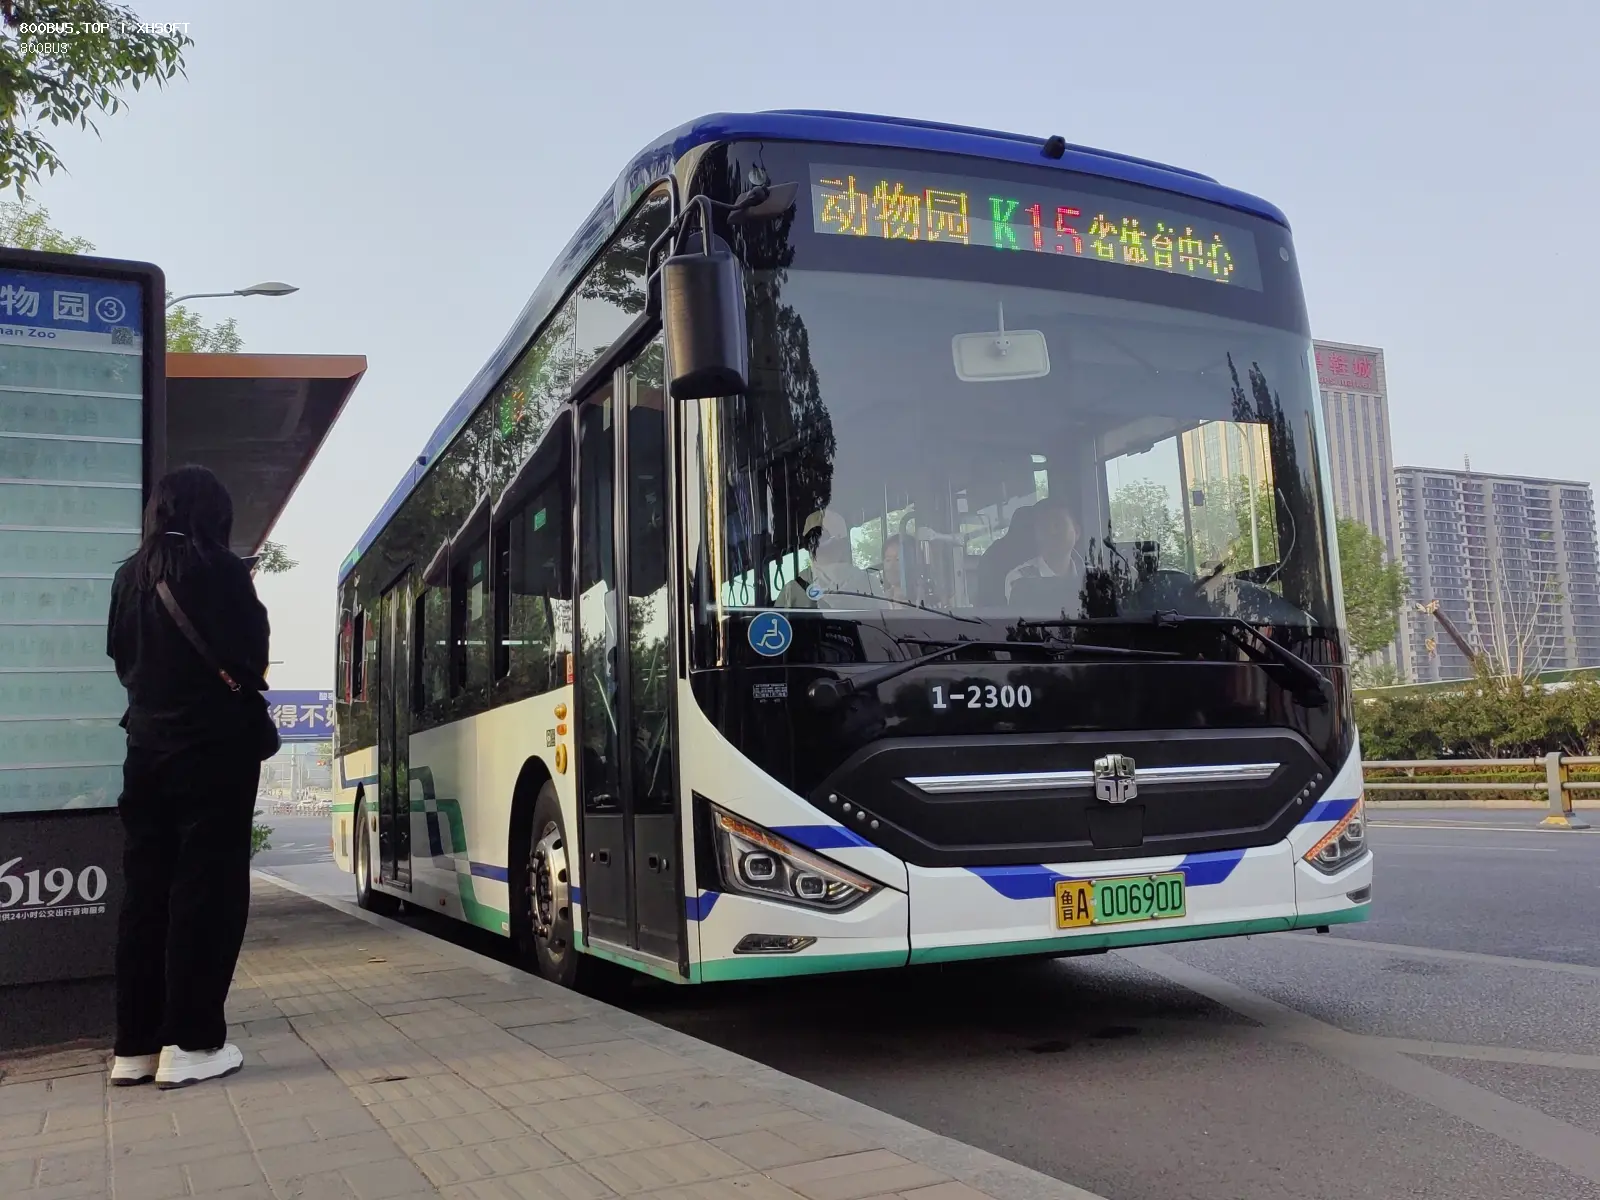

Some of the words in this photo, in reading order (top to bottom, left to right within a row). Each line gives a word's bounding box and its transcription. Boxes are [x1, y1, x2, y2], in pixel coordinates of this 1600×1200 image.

[820, 175, 968, 245] 动物园
[989, 197, 1082, 254] K15
[28, 328, 56, 339] Zoo
[932, 685, 1032, 709] 1-2300
[0, 856, 108, 908] 6190
[0, 906, 106, 921] 供24小时公交出行咨询服务
[1060, 888, 1089, 922] 鲁A
[1101, 880, 1183, 917] 00690D
